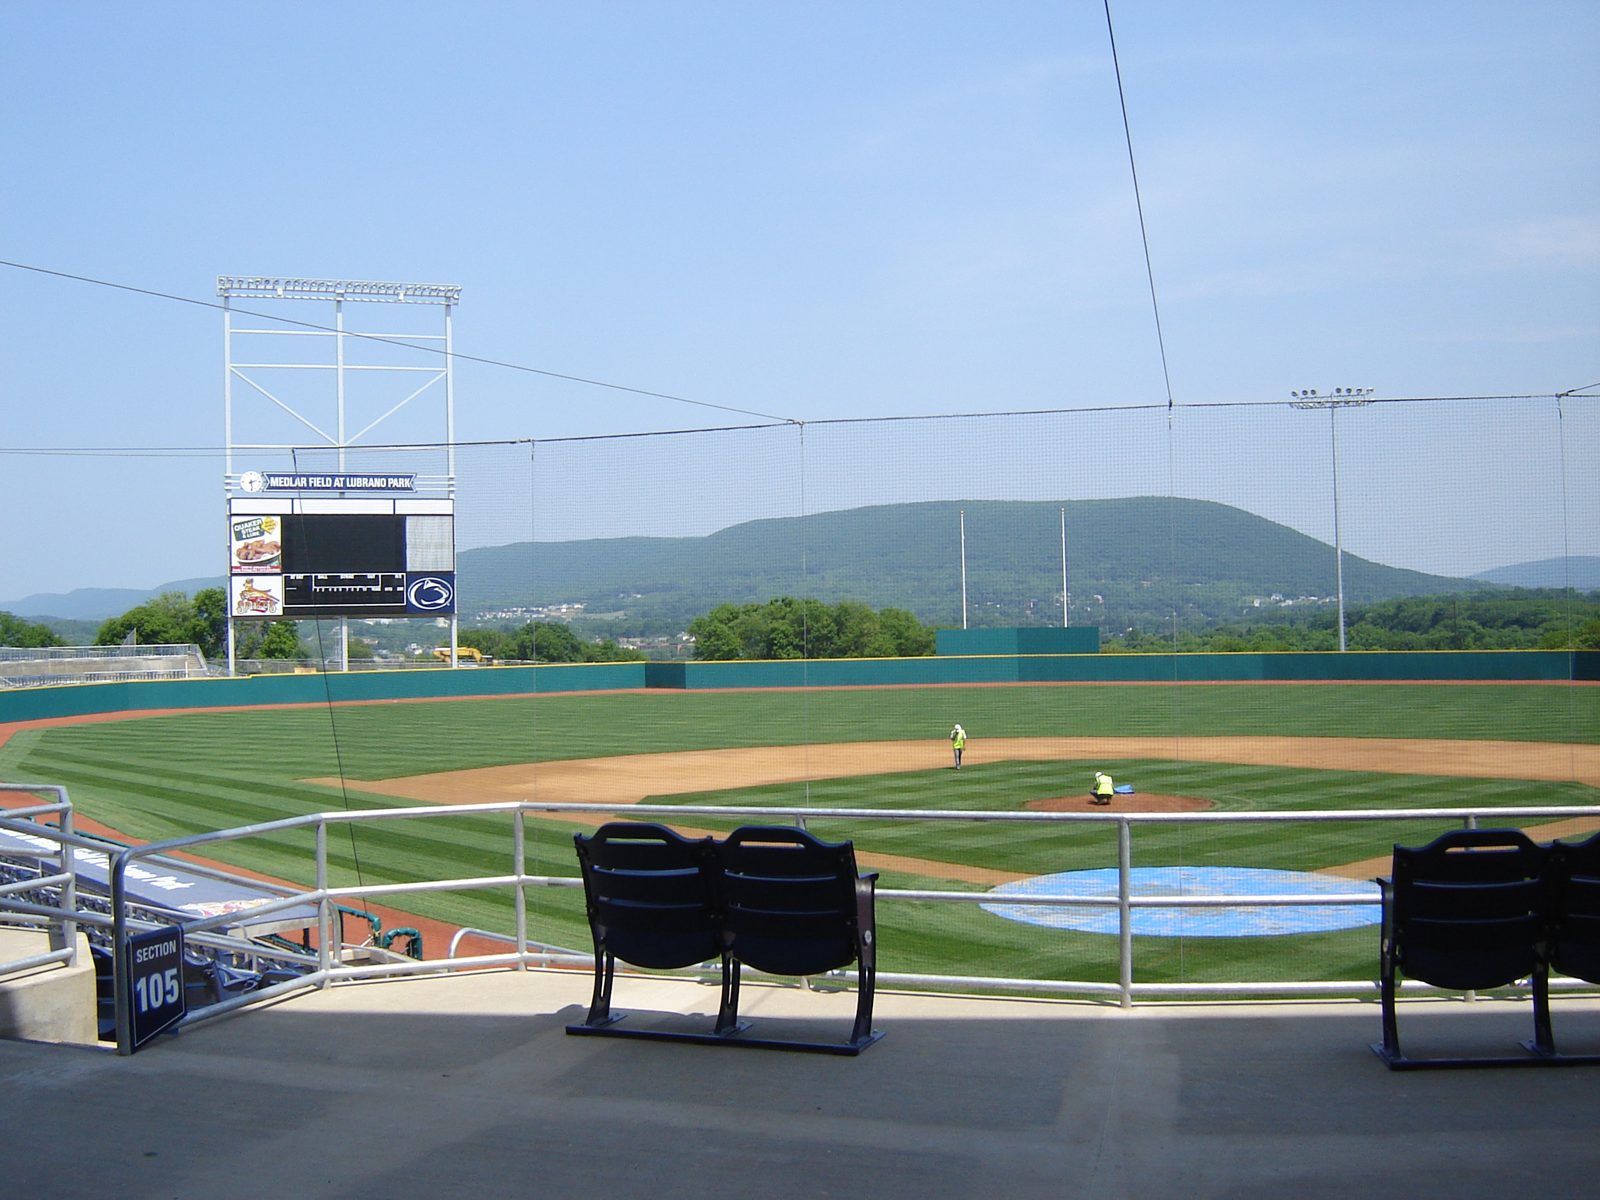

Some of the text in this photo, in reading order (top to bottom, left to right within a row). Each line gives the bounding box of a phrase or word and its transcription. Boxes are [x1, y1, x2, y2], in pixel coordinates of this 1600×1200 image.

[269, 476, 411, 488] MEDLAR FIELD AT LUBRANO PARK
[234, 519, 262, 533] QUAKER
[136, 939, 177, 963] SECTION
[136, 967, 179, 1012] 105
